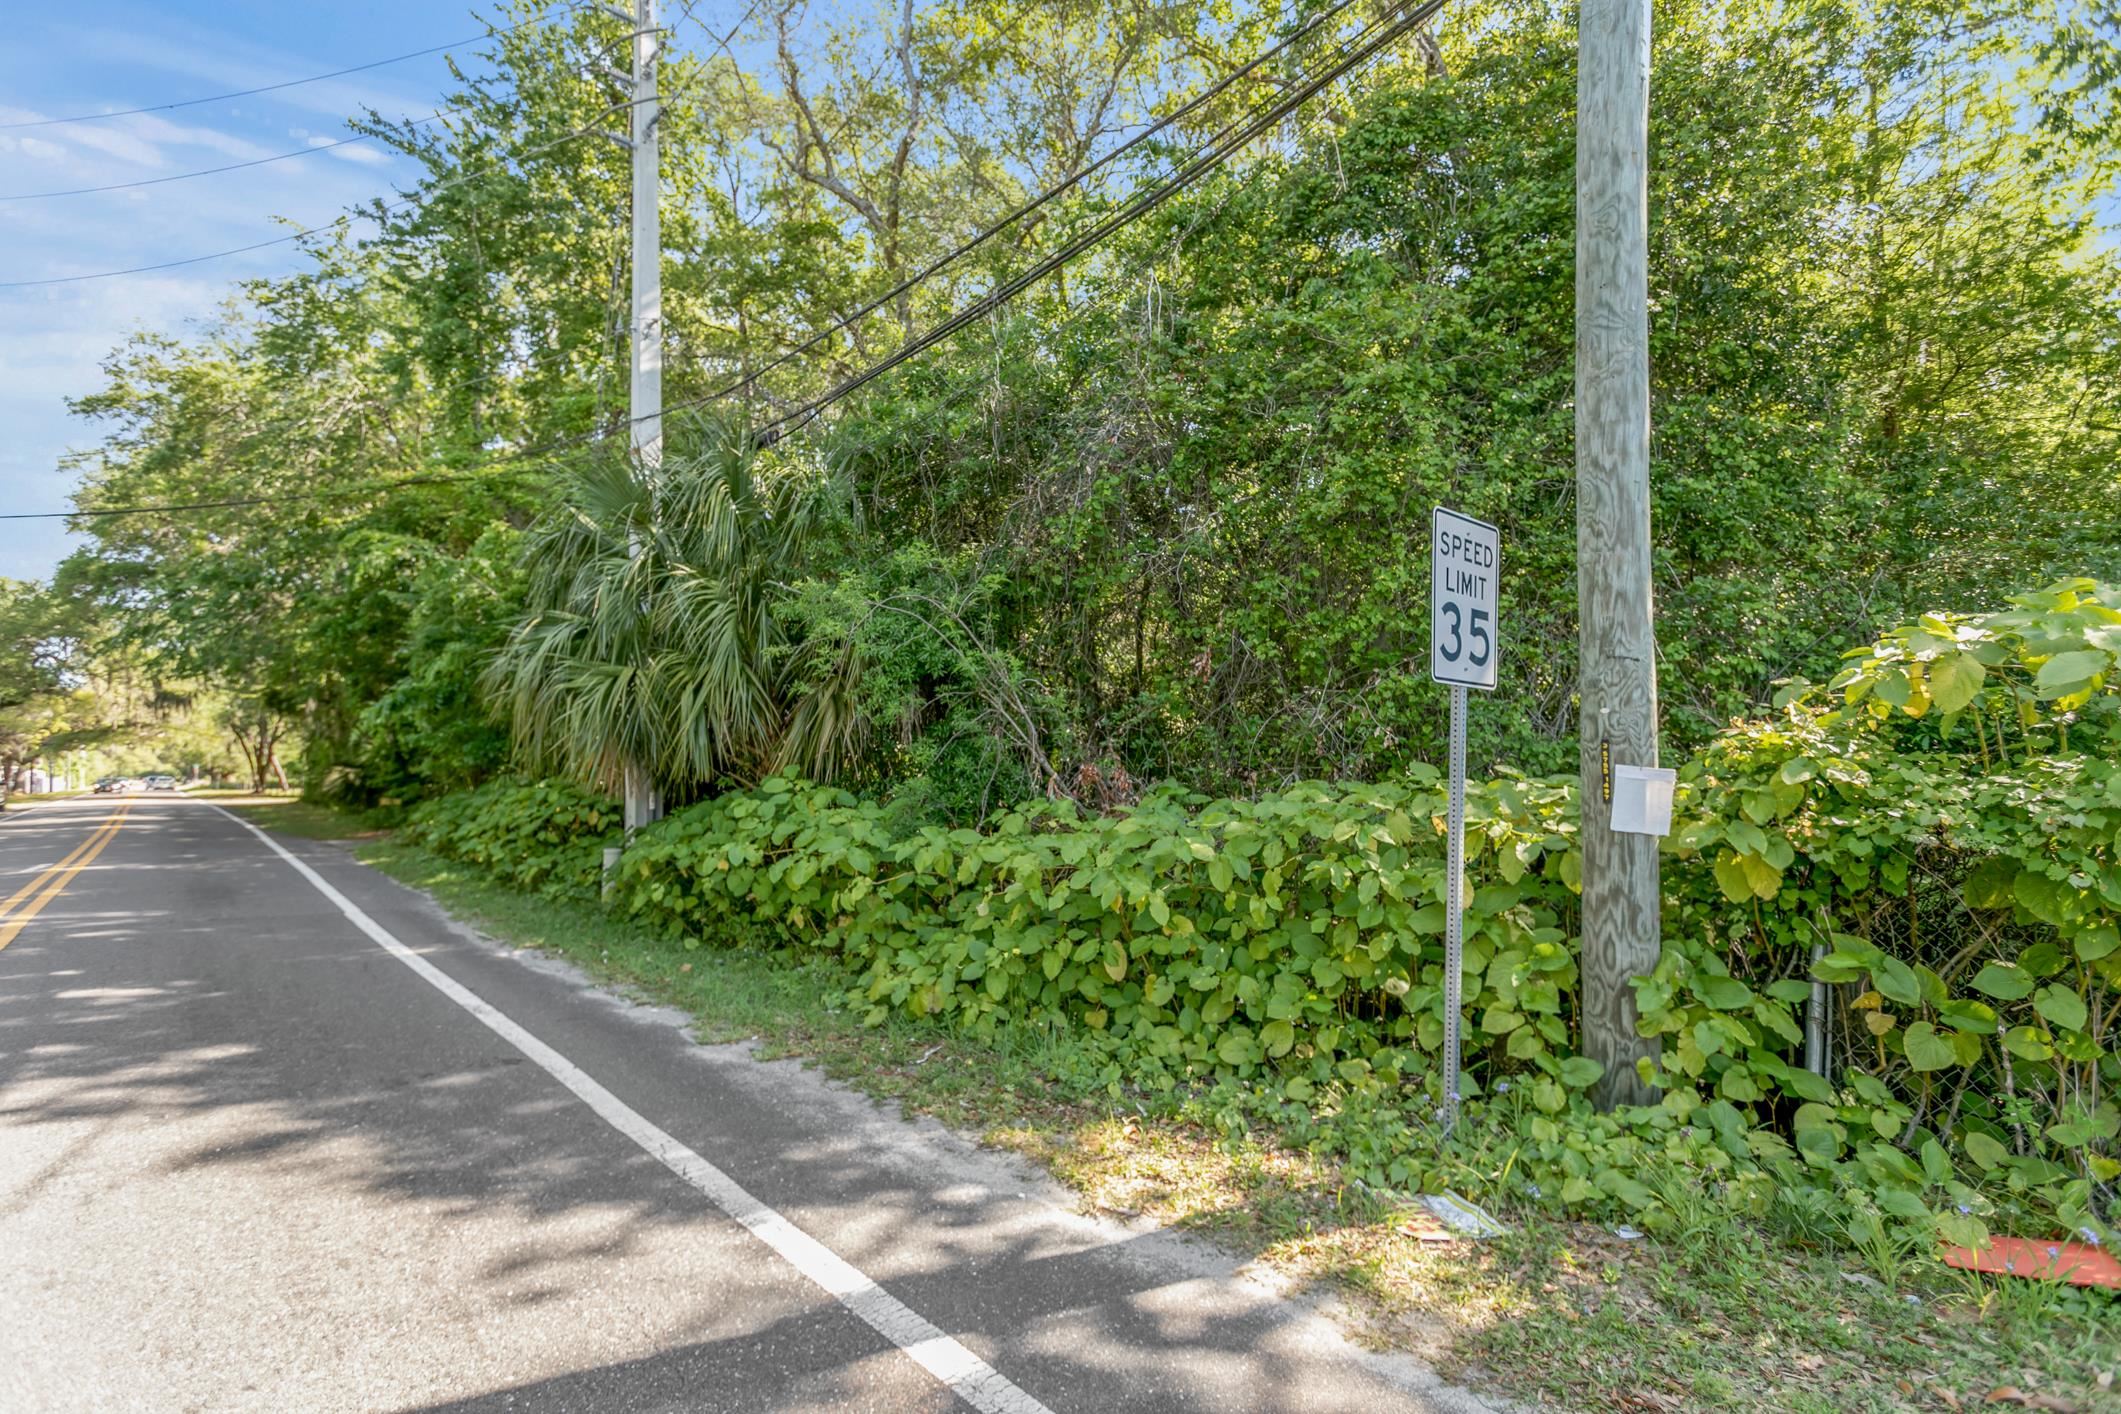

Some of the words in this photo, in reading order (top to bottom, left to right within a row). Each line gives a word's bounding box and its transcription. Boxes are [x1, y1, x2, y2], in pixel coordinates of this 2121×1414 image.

[1440, 531, 1493, 568] SPEED
[1446, 567, 1487, 600] LIMIT
[1440, 601, 1490, 667] 35
